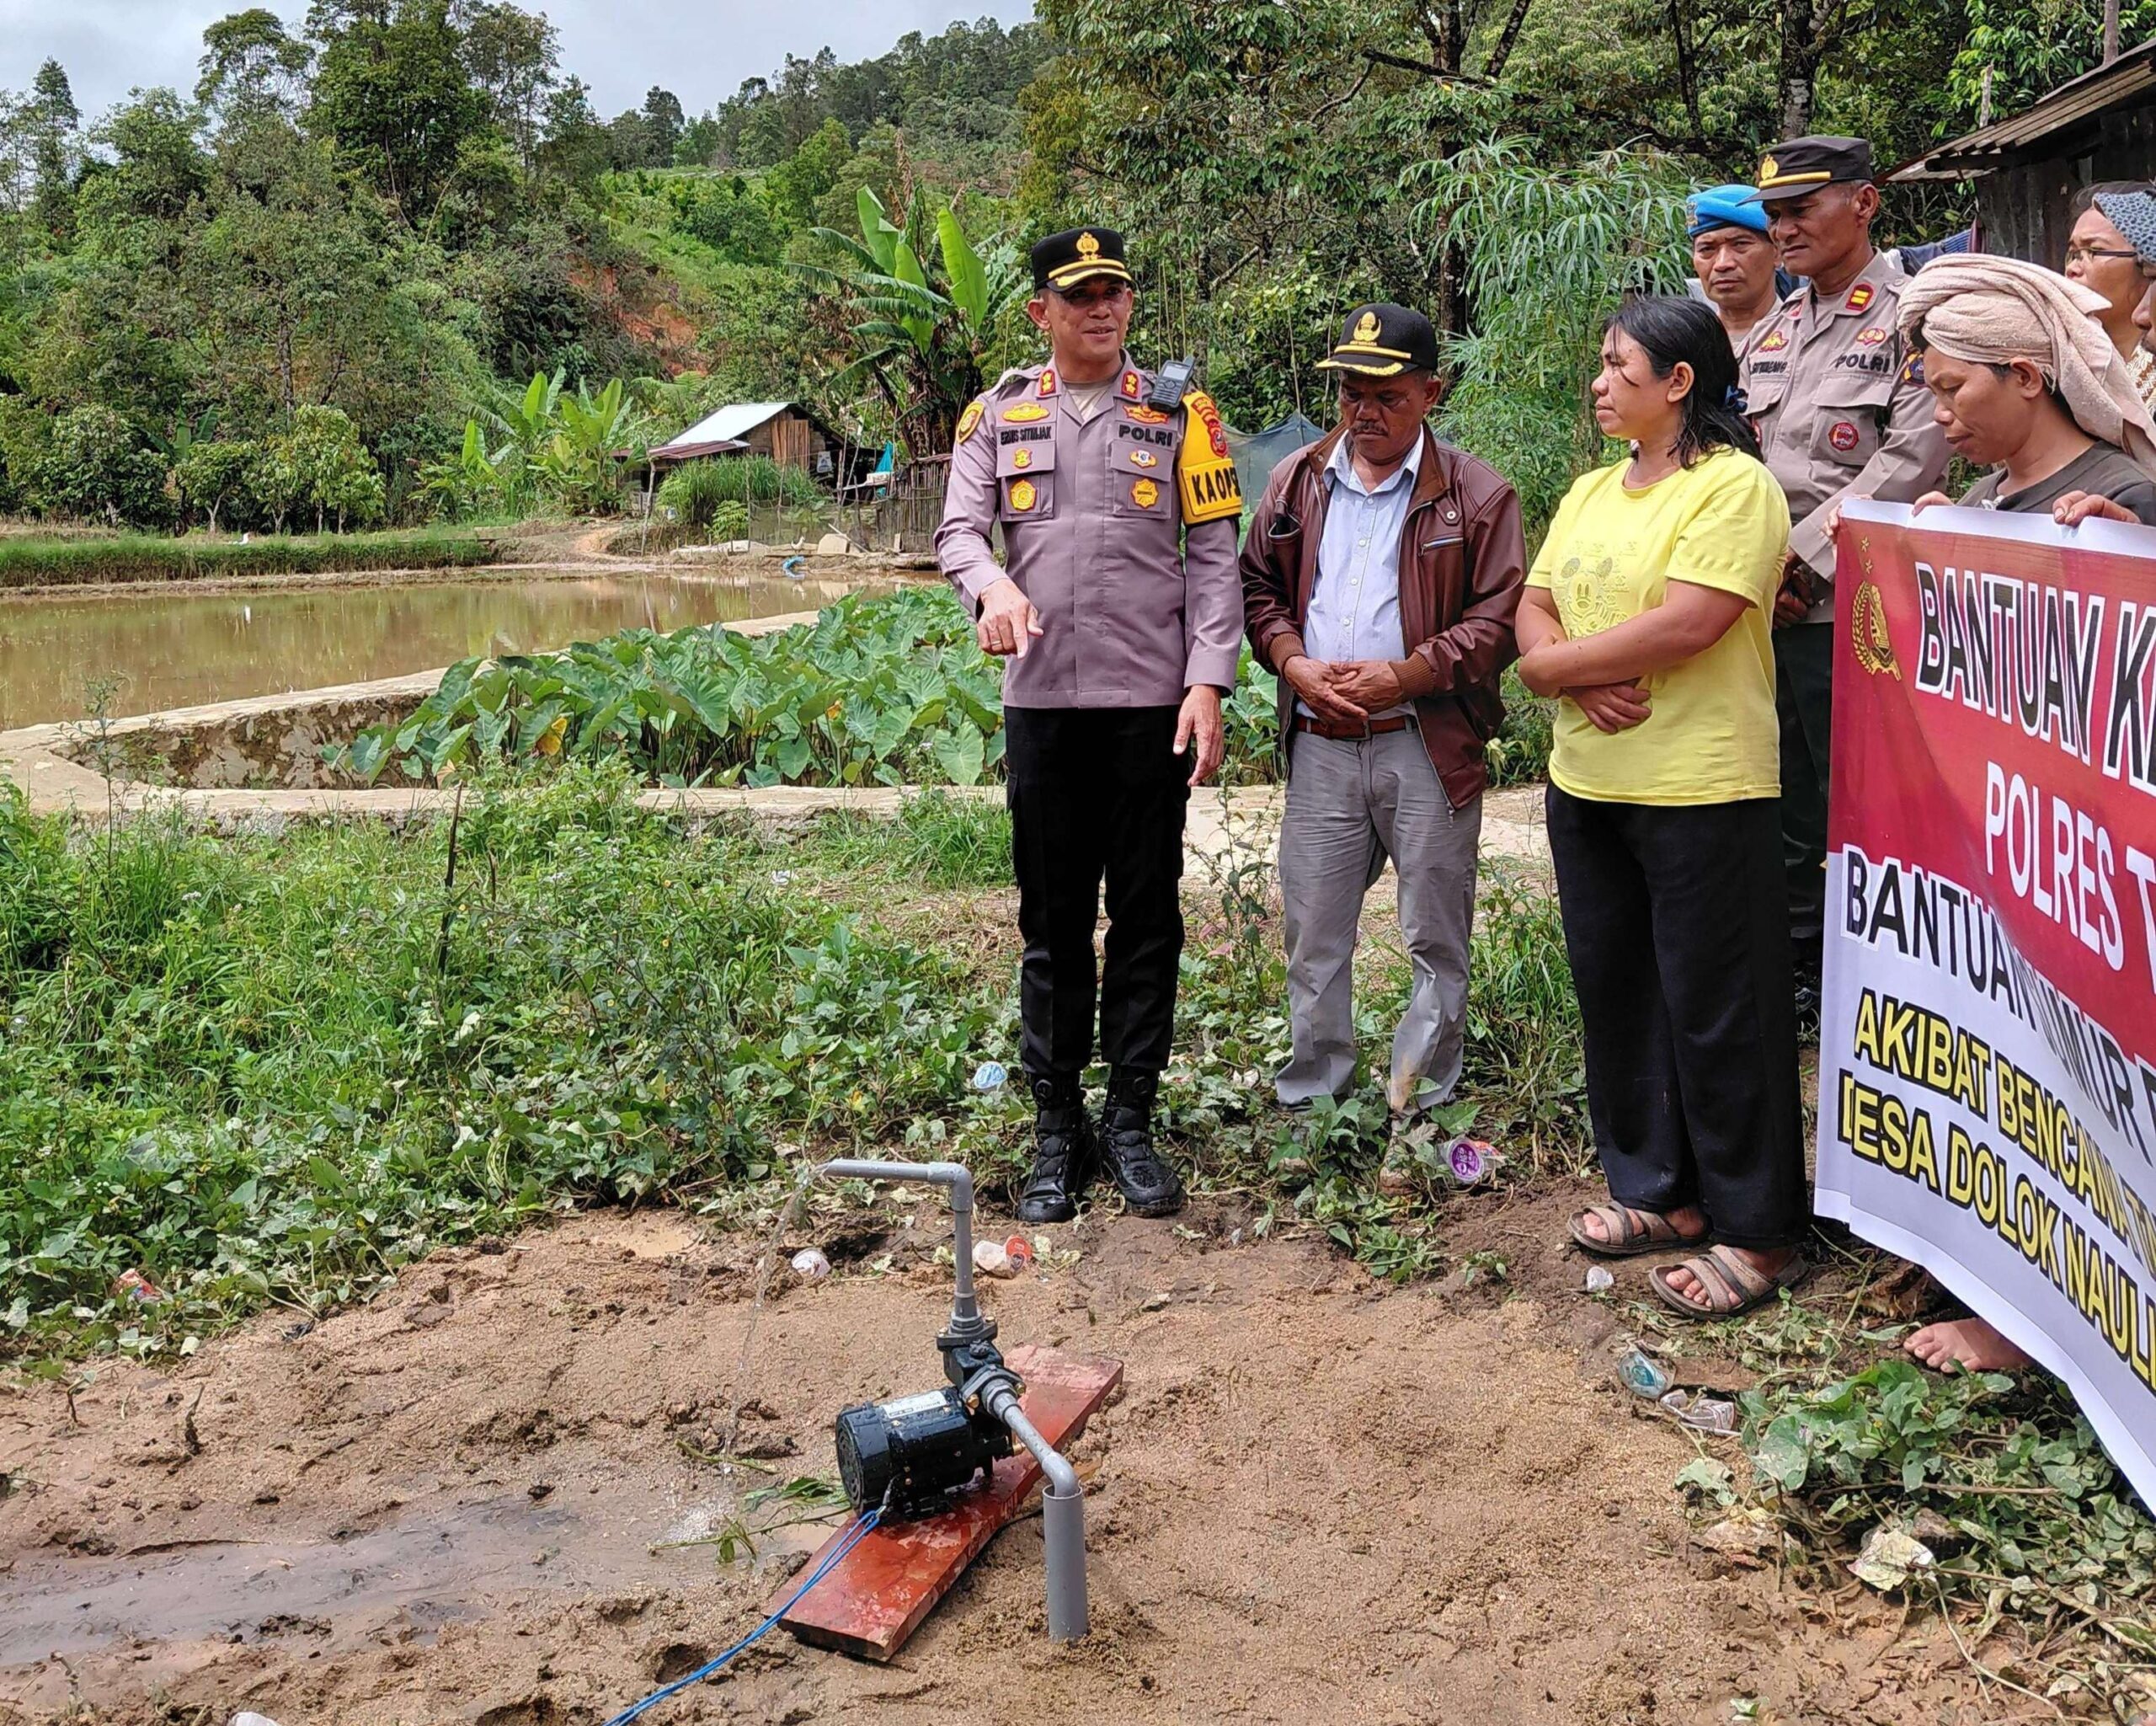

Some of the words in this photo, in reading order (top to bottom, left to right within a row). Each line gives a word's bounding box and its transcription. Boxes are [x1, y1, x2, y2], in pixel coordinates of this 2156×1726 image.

[1118, 424, 1173, 447] POLRI
[1834, 354, 1891, 373] POLRI
[1915, 563, 2105, 765] BANTUAN
[2103, 601, 2156, 797] K
[1844, 846, 2039, 1034] BANTUAN
[1985, 760, 2124, 971] POLRES
[1854, 986, 1991, 1123] AKIBAT
[1994, 1050, 2143, 1267] BENCANA
[1945, 1121, 2064, 1296] DOLOK
